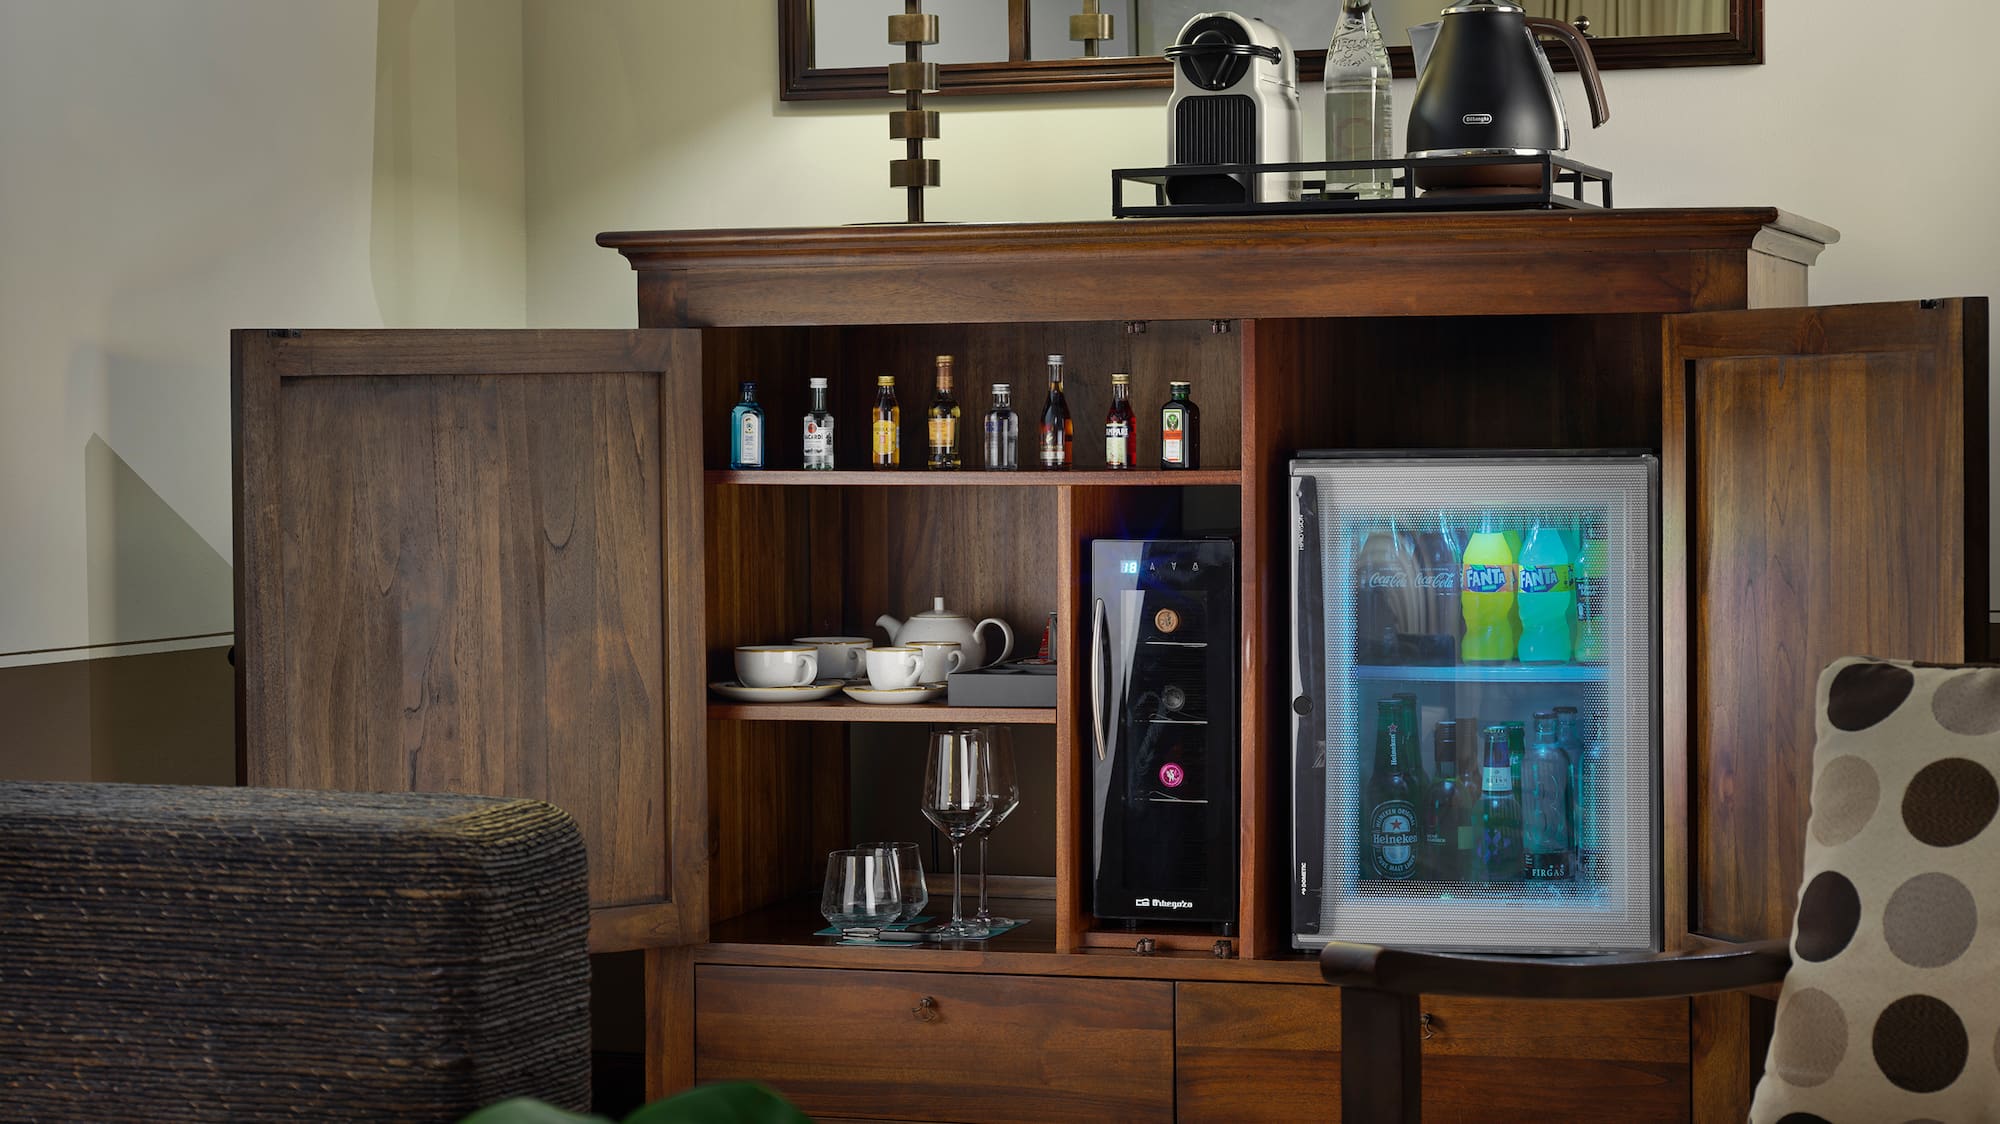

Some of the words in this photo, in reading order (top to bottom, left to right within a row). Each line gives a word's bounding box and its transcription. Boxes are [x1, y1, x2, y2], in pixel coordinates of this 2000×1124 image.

[1123, 562, 1137, 573] 18
[1466, 568, 1506, 588] FANTA
[1520, 568, 1559, 588] FANTA
[1531, 868, 1565, 877] FIRGAS
